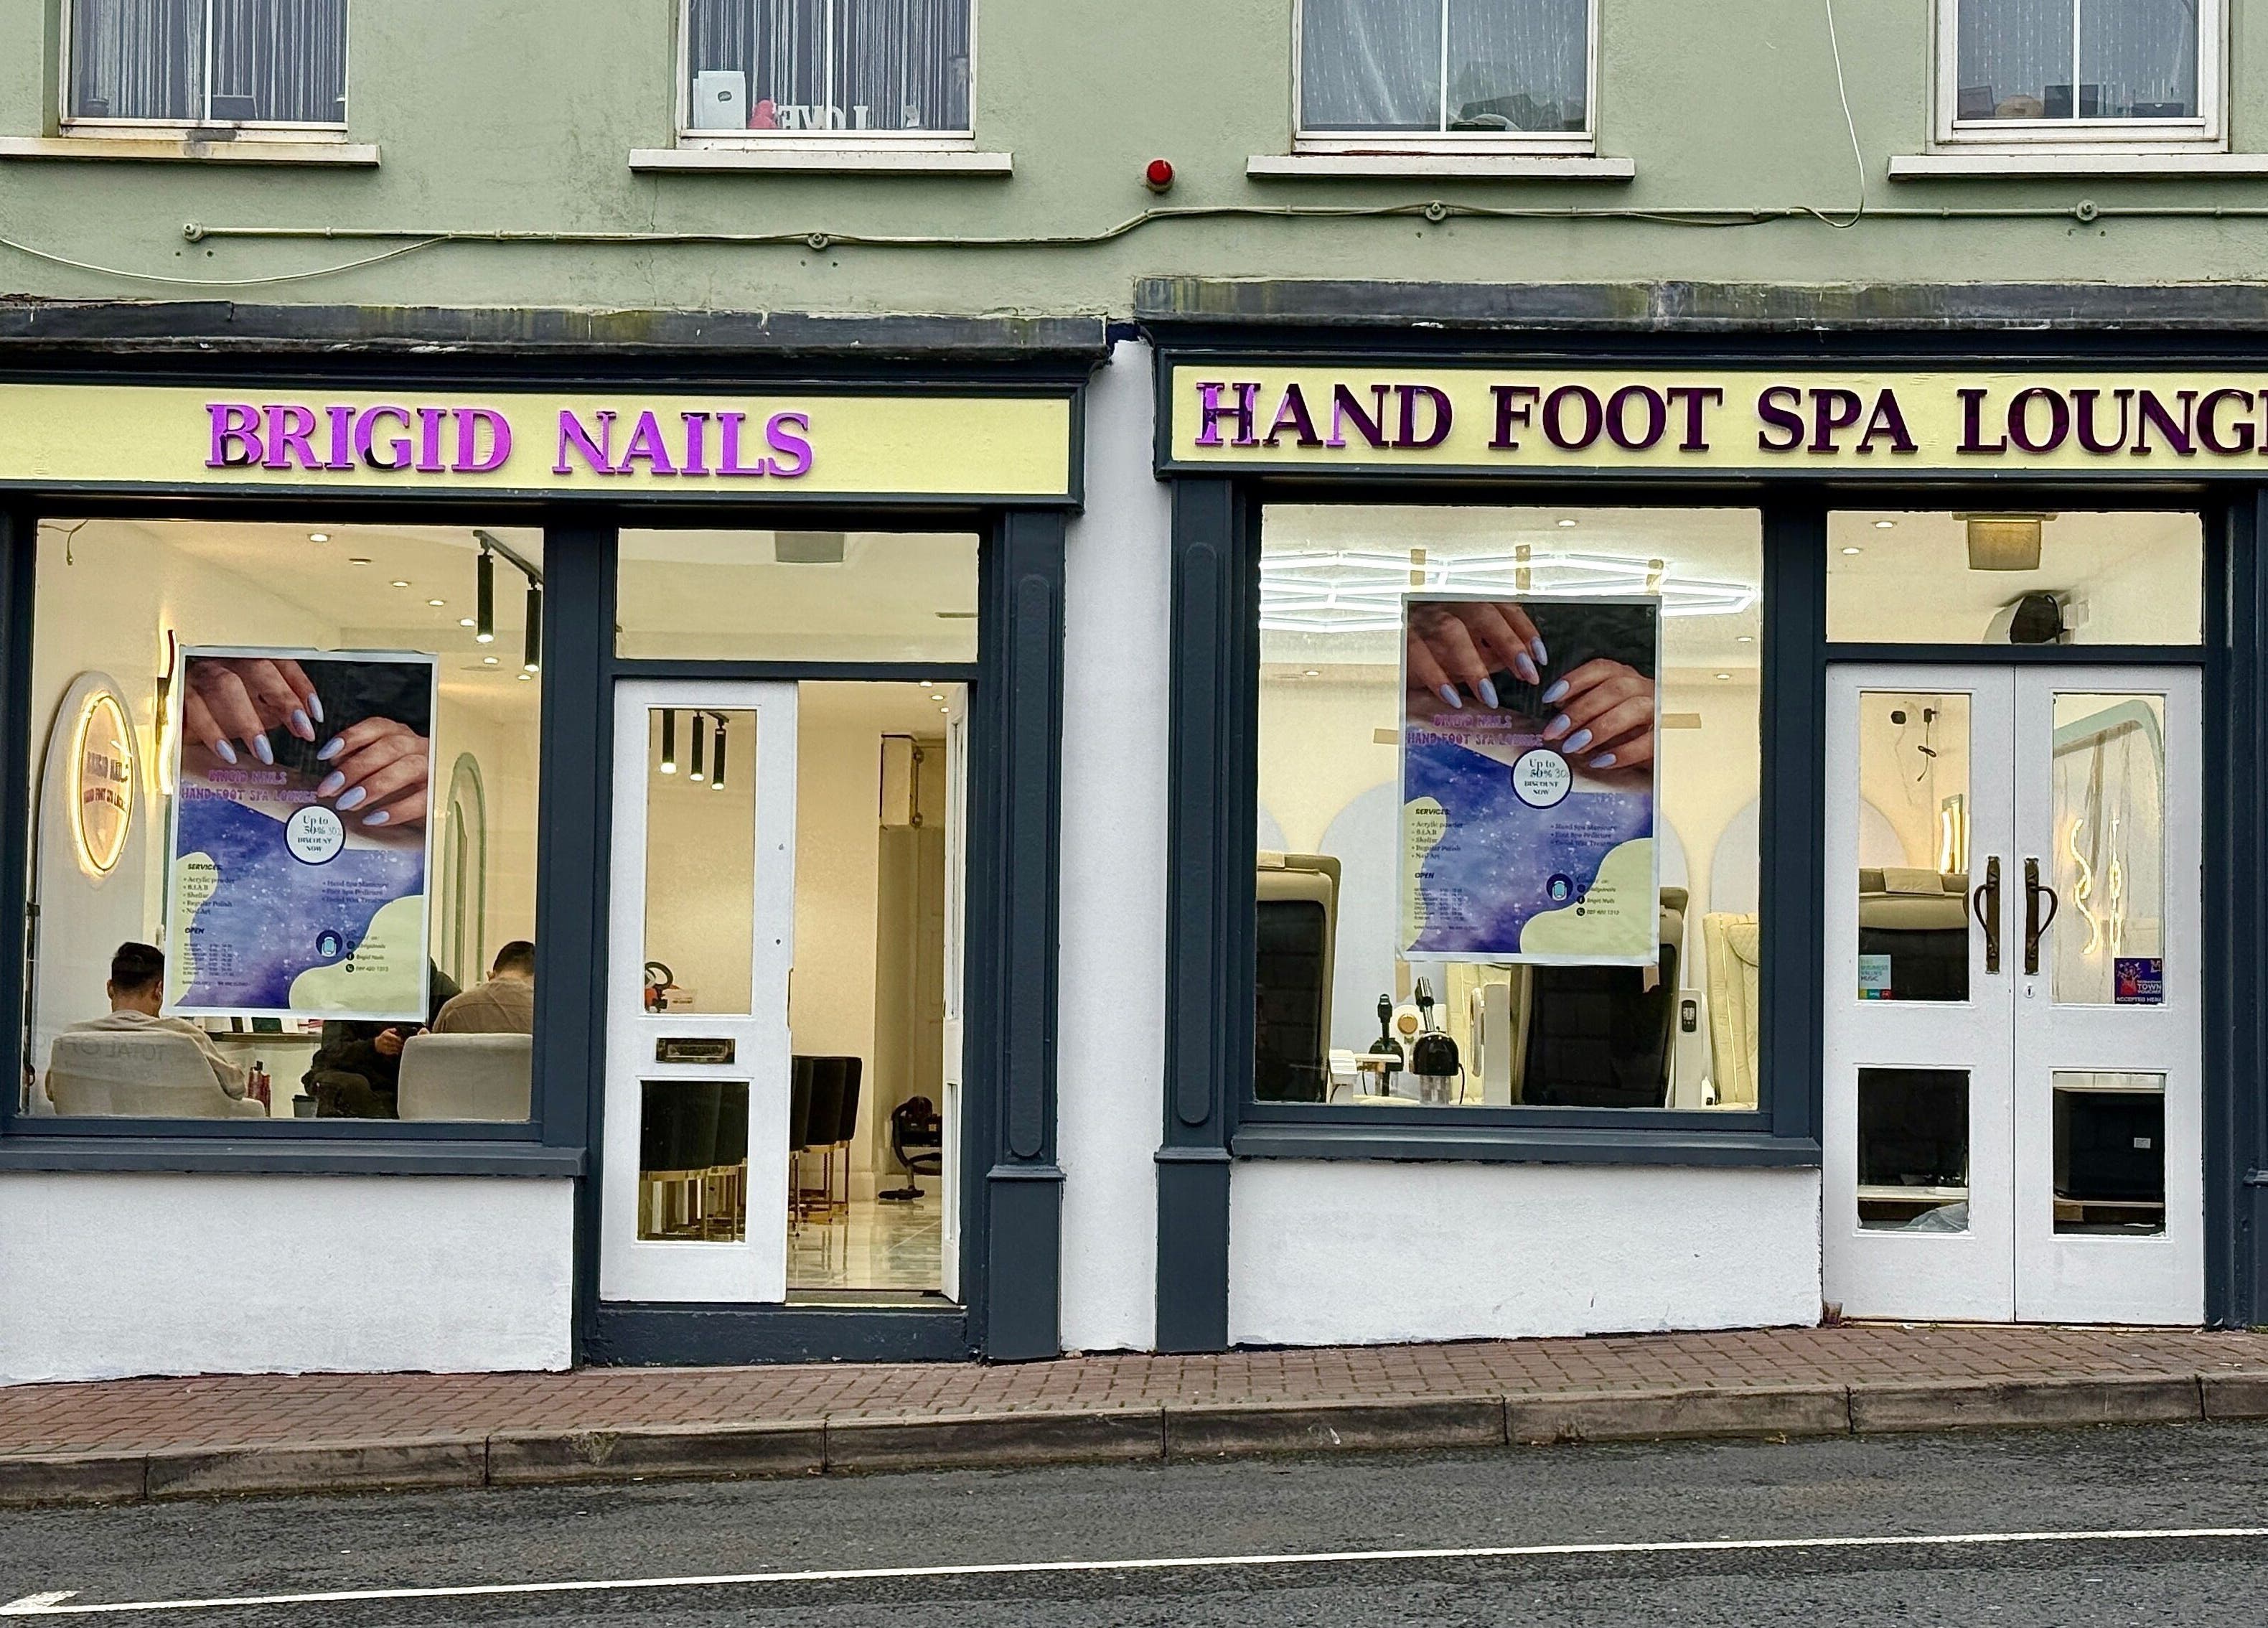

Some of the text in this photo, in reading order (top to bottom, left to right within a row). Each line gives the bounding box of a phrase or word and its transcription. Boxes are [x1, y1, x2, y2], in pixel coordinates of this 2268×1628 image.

[1195, 382, 2268, 457] HAND FOOT SPA LOUNG
[205, 403, 814, 477] BRIGID NAILS
[1476, 715, 1513, 729] NAILS
[1407, 732, 1438, 745] HAND
[1443, 733, 1471, 746] FOOT
[1476, 734, 1496, 746] SPA
[1529, 758, 1543, 769] Up
[252, 771, 287, 785] NAILS
[181, 788, 212, 800] HAND
[216, 790, 245, 801] FOOT
[250, 790, 269, 802] SPA
[303, 815, 317, 826] Up
